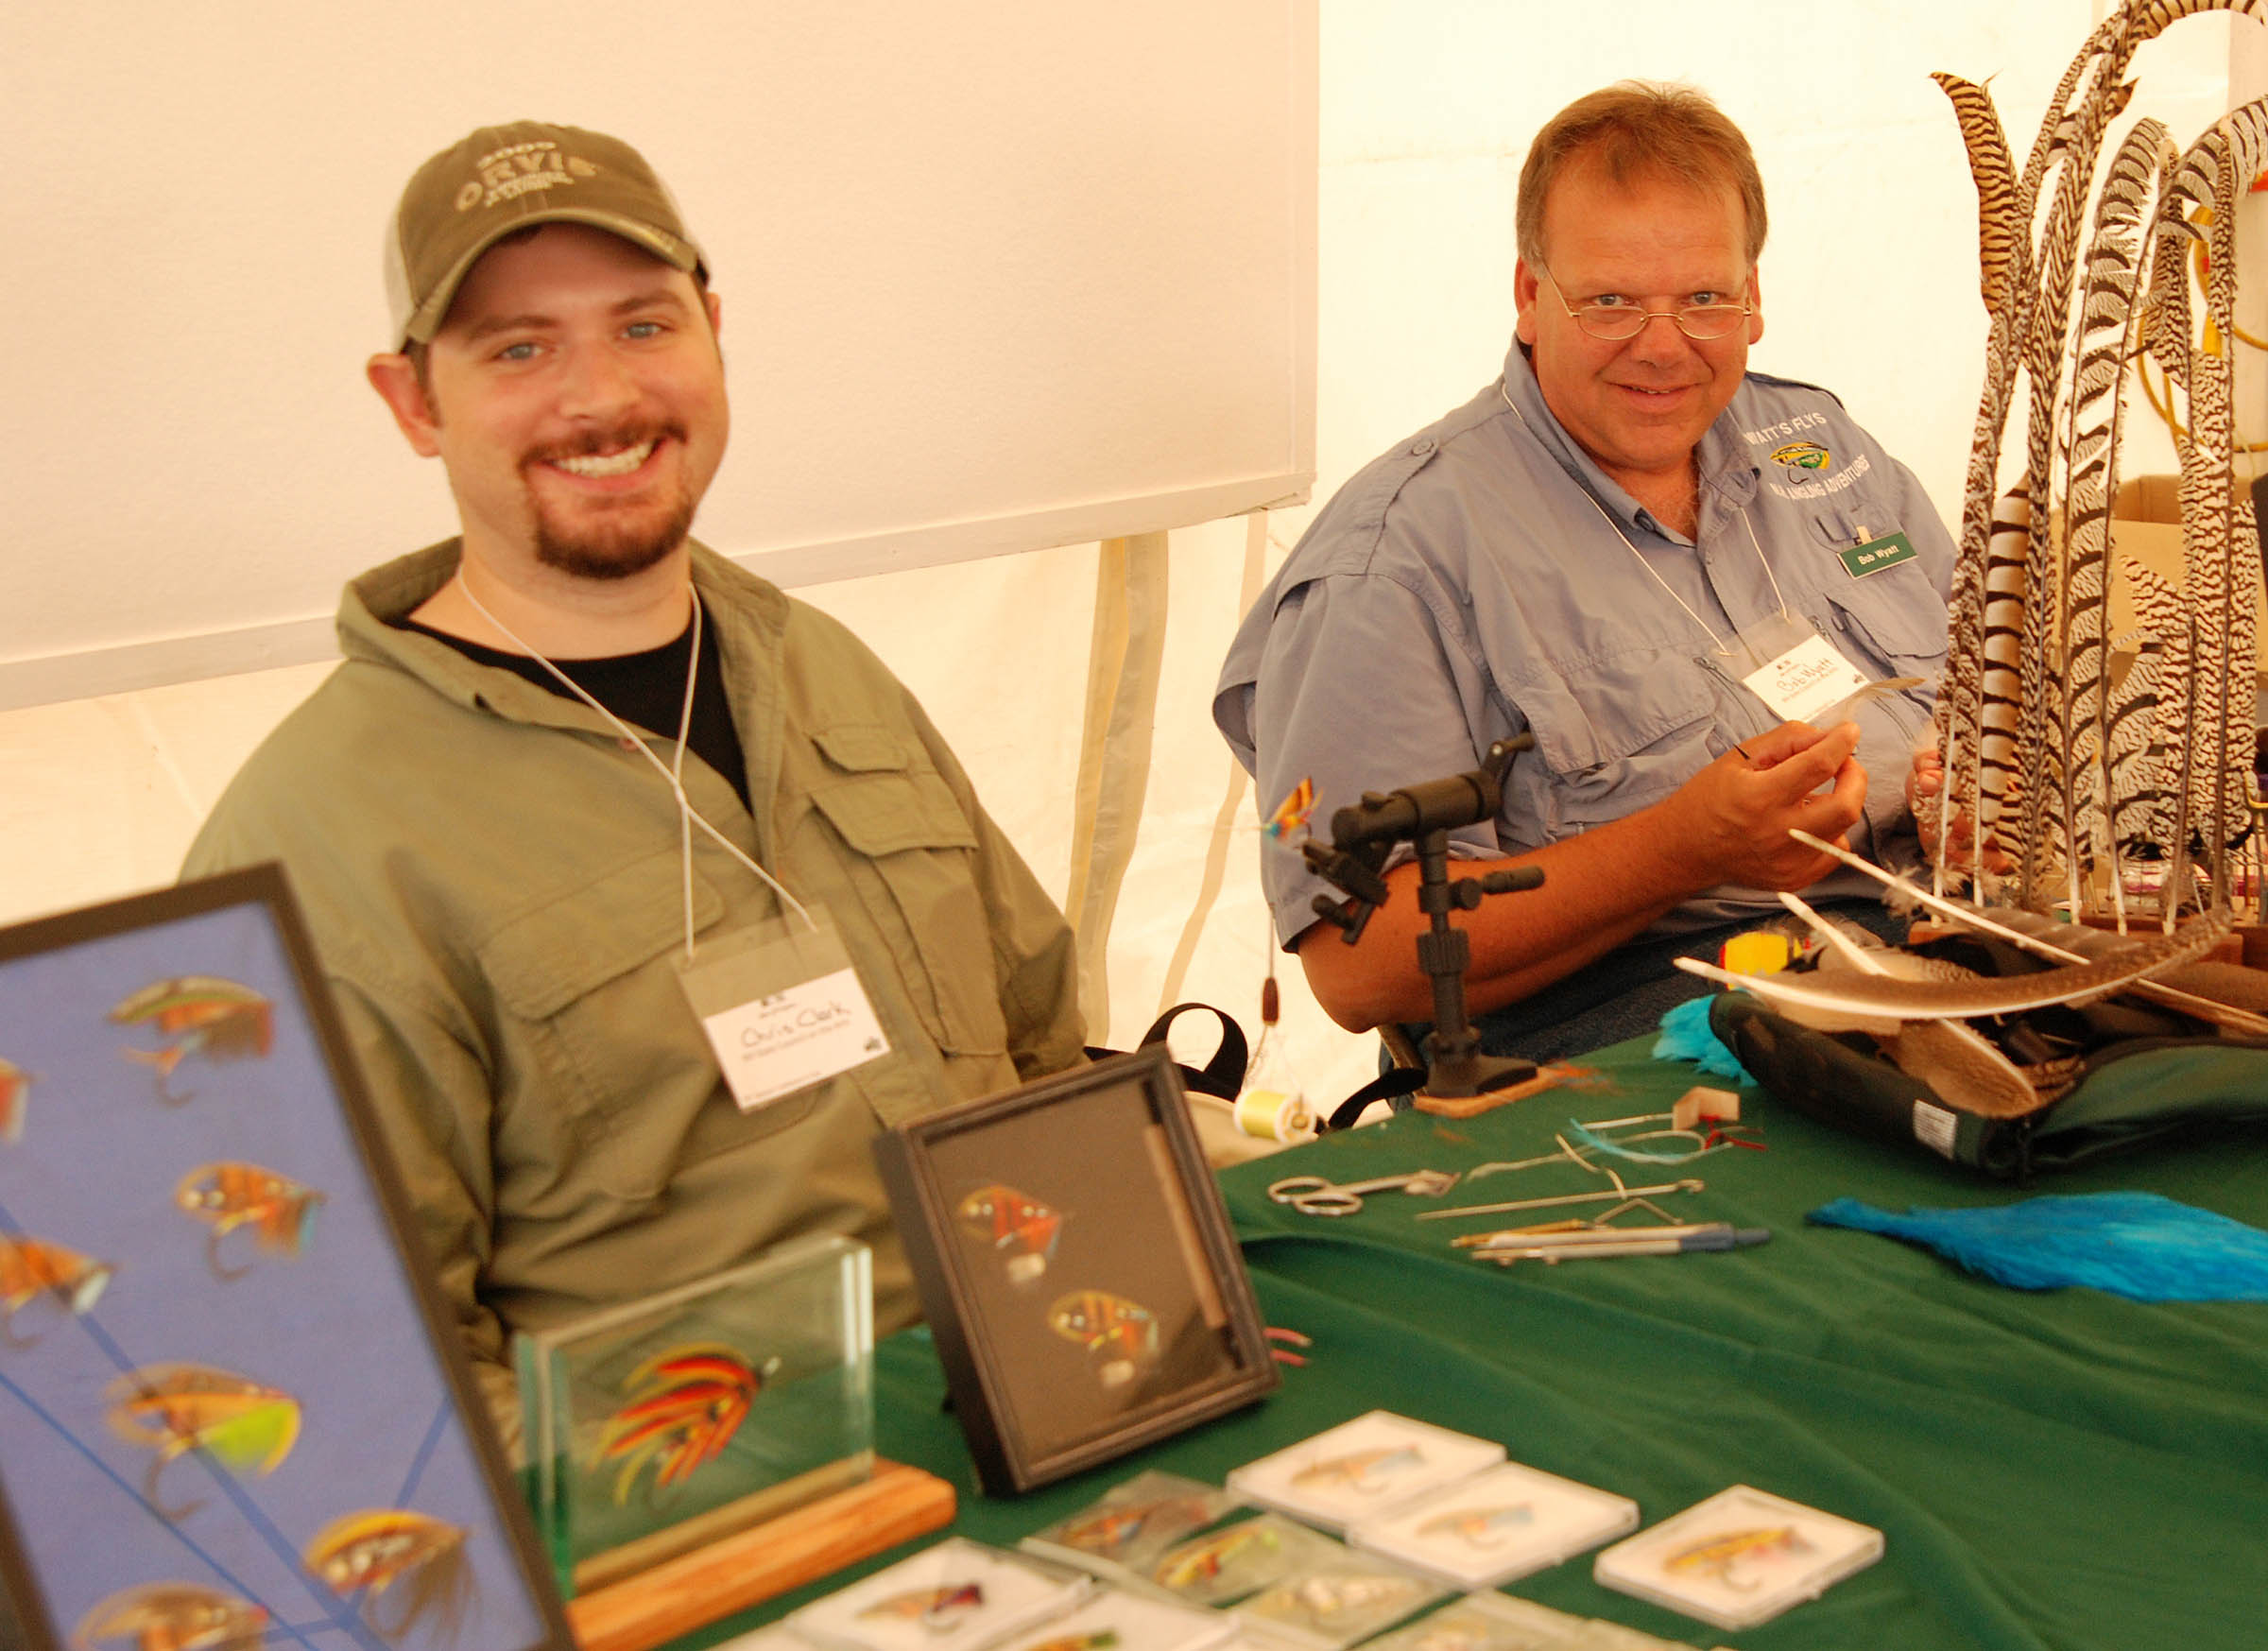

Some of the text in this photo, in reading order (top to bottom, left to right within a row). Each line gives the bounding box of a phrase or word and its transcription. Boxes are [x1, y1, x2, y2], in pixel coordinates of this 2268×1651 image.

[1792, 412, 1827, 432] FLYS
[1858, 544, 1899, 565] Bob Wyatt
[1777, 676, 1807, 691] Bob
